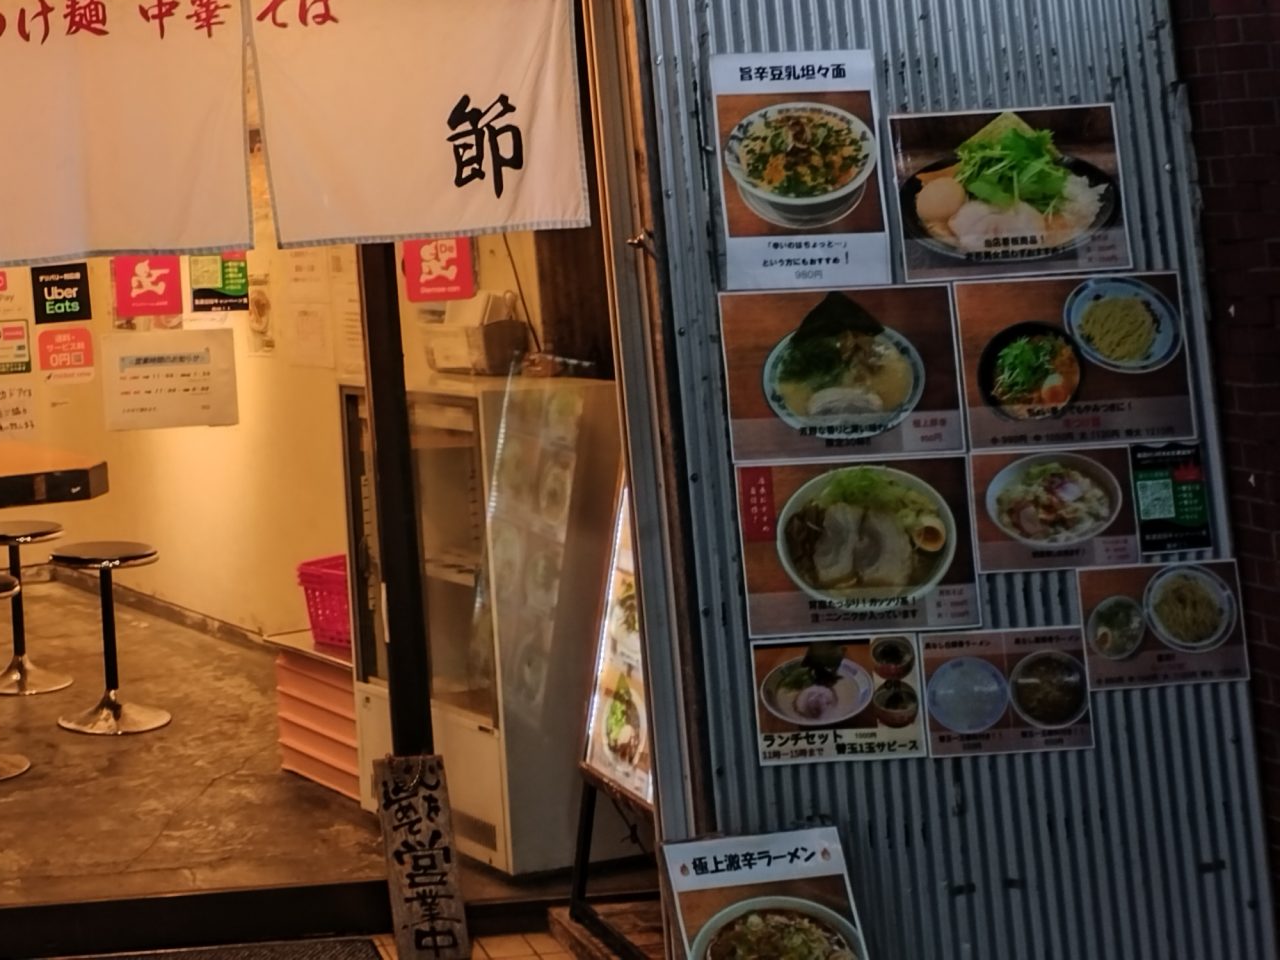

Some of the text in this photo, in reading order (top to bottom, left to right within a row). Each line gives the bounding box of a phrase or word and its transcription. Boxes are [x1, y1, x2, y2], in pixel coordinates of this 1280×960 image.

[446, 92, 524, 200] 節
[44, 286, 79, 301] Uber
[45, 300, 81, 314] Eats
[762, 730, 843, 748] ランチセット
[692, 846, 816, 876] 極上激辛ラーメン
[391, 828, 463, 958] 営業中
